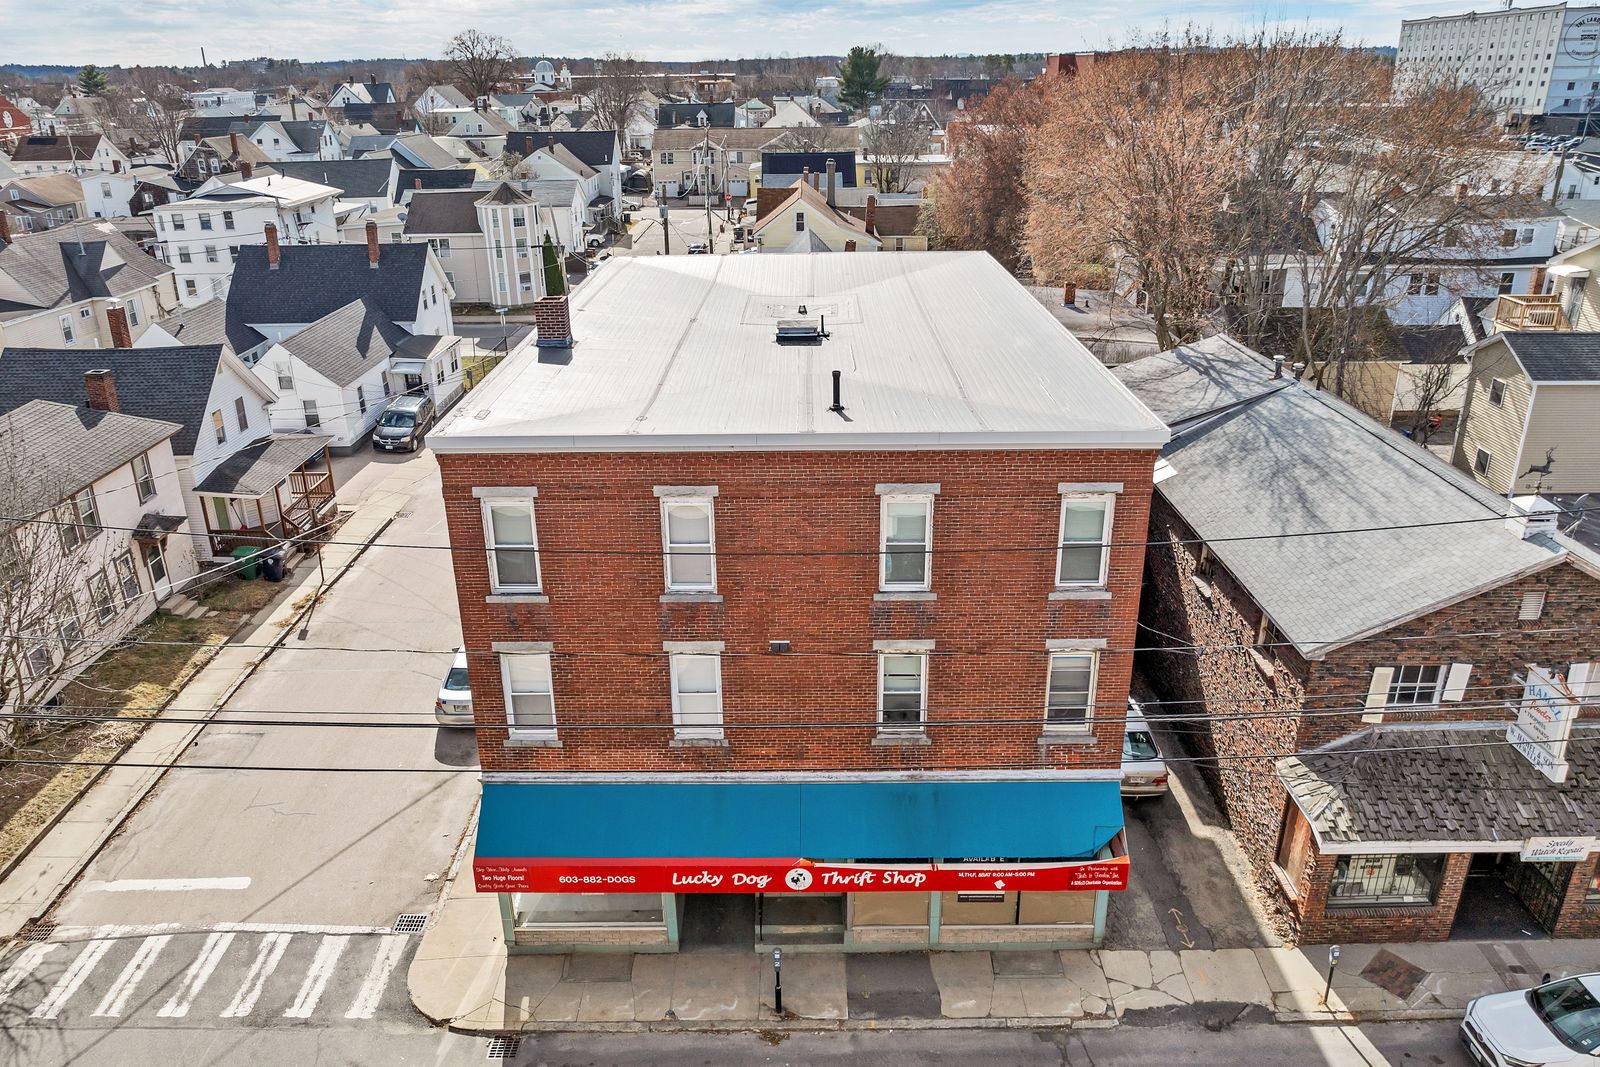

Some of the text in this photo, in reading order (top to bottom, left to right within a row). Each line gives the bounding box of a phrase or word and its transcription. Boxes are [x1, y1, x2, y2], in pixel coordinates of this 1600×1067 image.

[558, 875, 636, 884] 603-882-DOGS
[672, 870, 927, 888] Lucky Dog Thrift Shop
